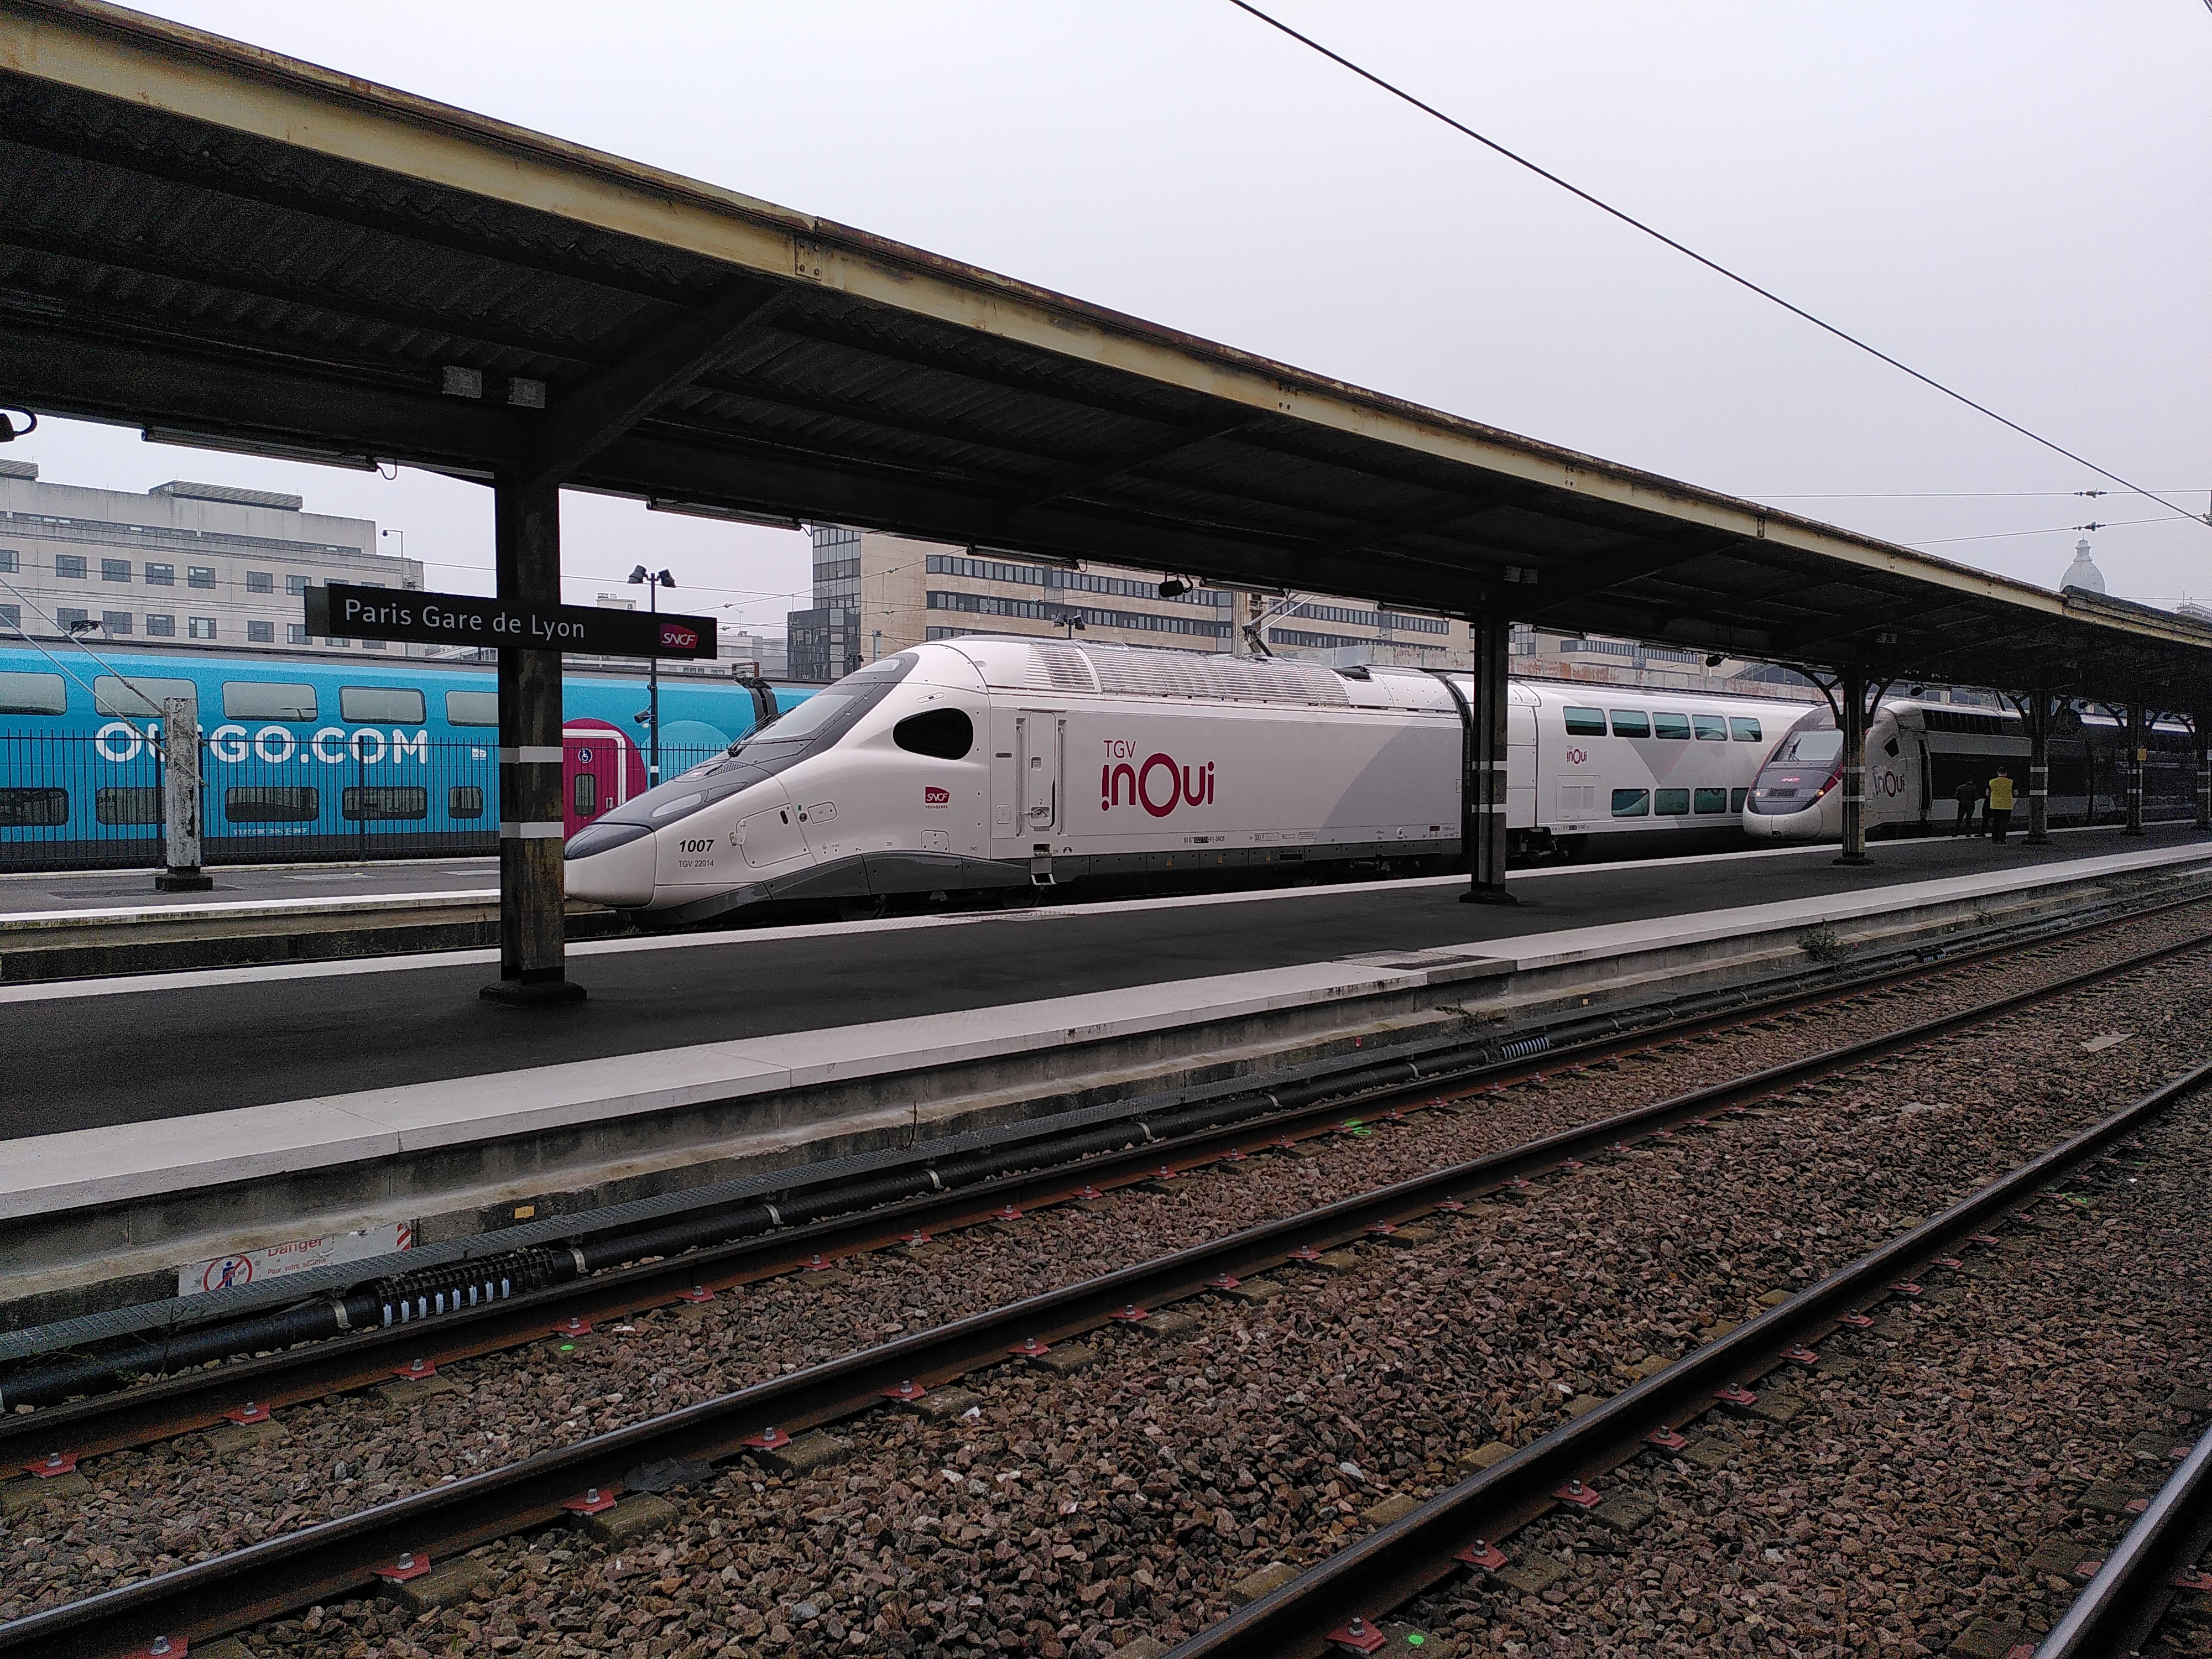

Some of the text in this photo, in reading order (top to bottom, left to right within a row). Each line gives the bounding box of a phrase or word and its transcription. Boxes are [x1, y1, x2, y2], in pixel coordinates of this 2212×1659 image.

[345, 599, 585, 640] Paris Gare de Lyon
[662, 632, 695, 645] SNCF
[96, 722, 427, 764] OGO.COM
[1103, 740, 1136, 759] TGV
[926, 792, 948, 801] SNCF
[679, 839, 714, 852] 1007
[268, 1238, 322, 1257] Danger
[267, 1267, 282, 1275] Pour
